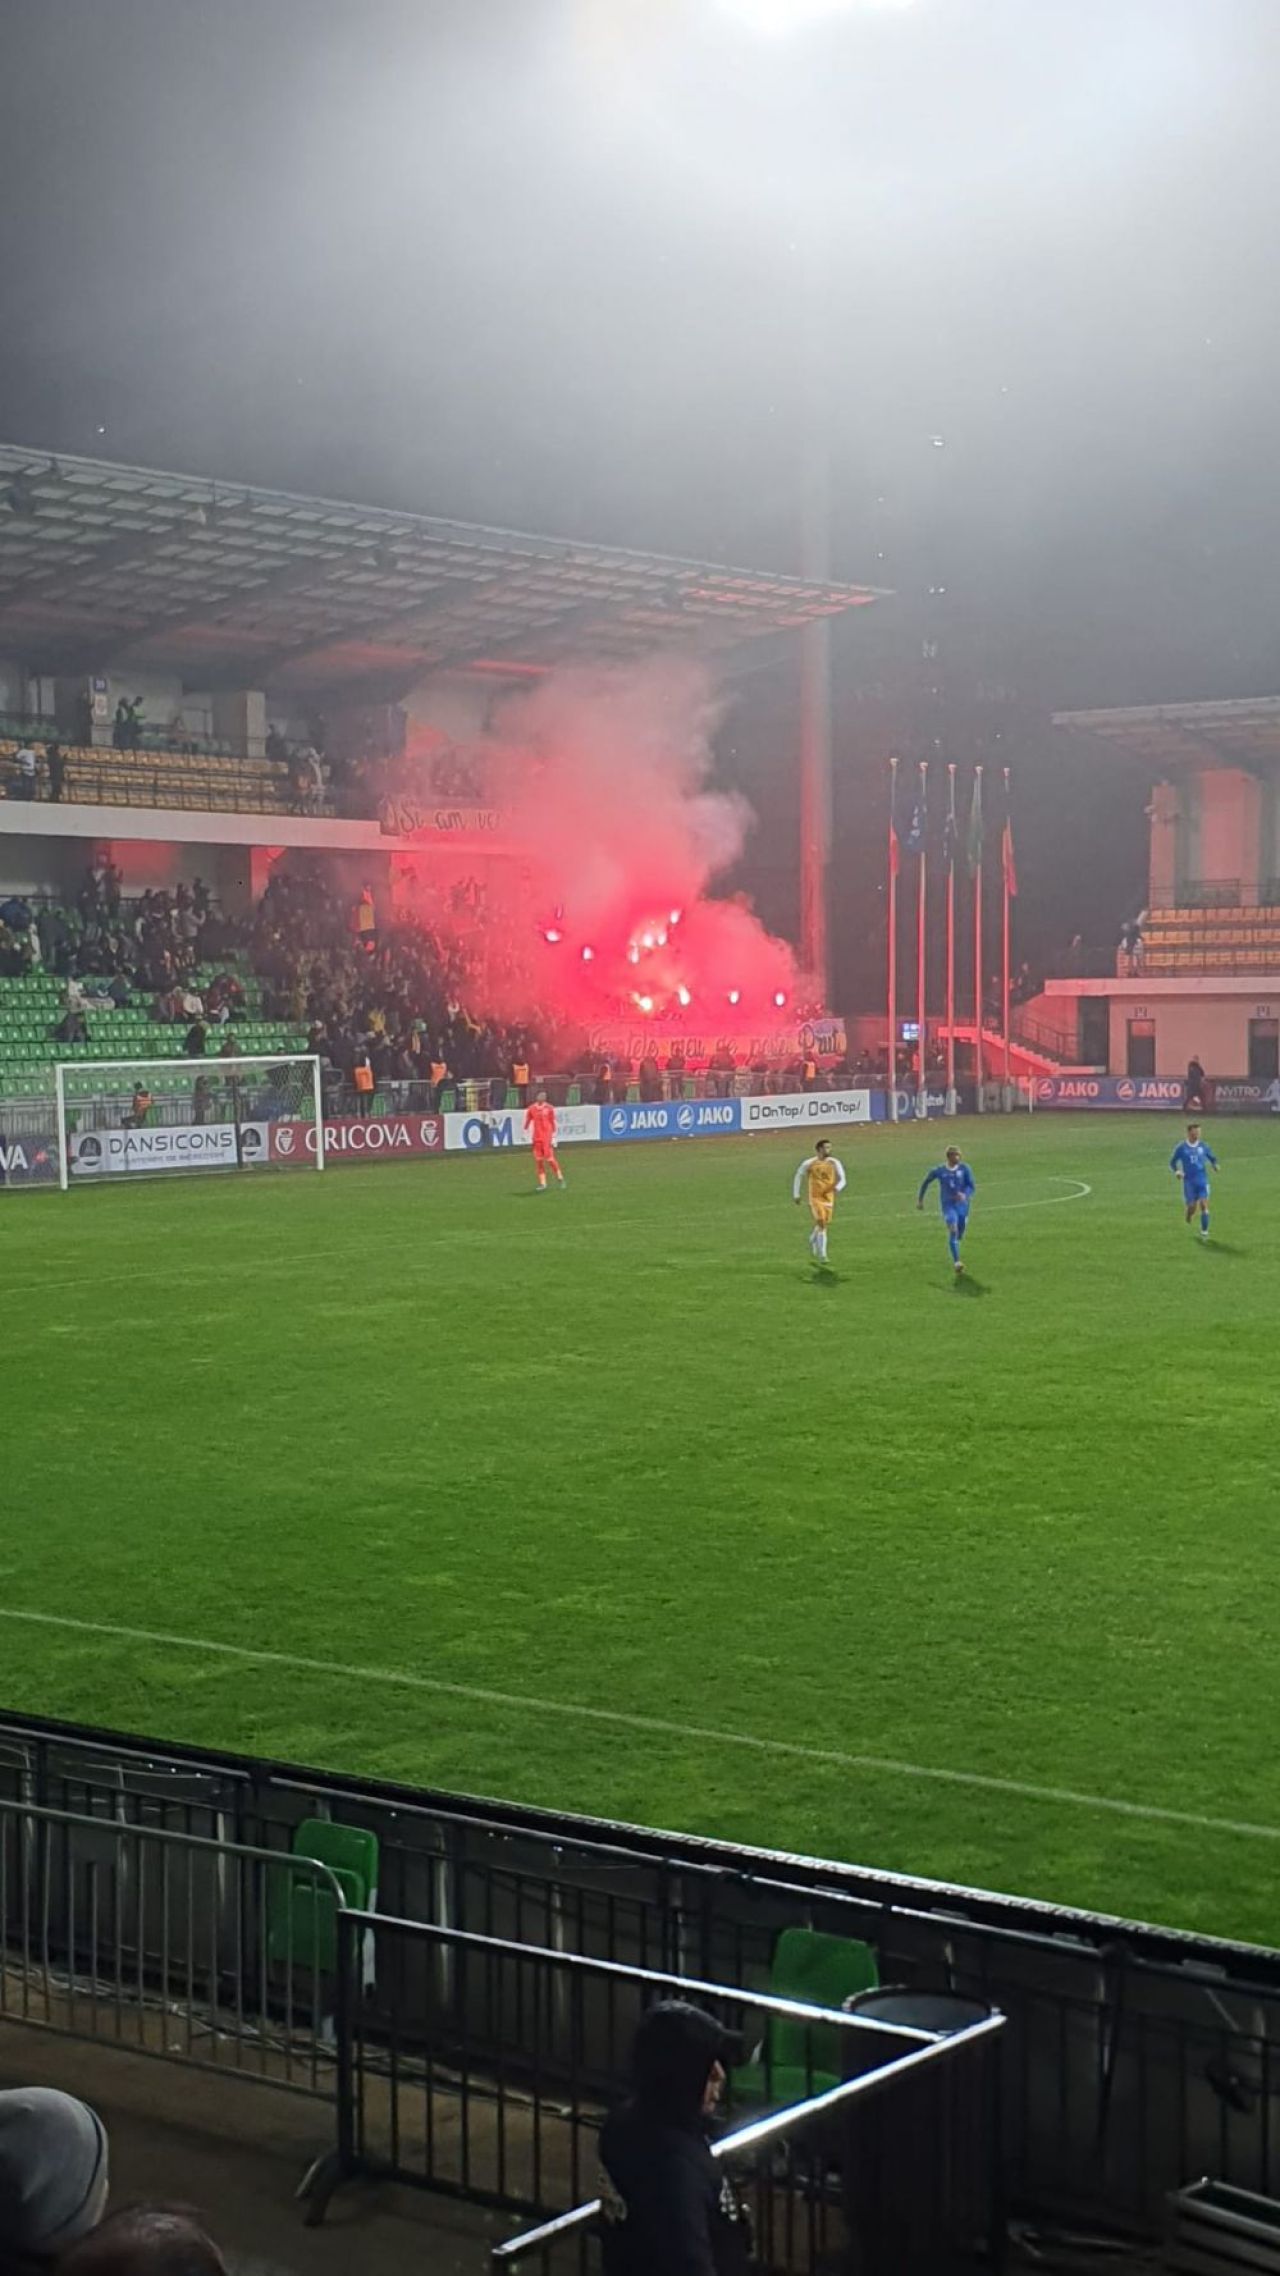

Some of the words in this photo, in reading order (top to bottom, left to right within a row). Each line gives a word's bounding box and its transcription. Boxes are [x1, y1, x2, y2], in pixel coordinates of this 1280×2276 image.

[1058, 1081, 1098, 1096] JAKO
[1139, 1083, 1181, 1098] JAKO
[1216, 1085, 1261, 1097] INVITRO
[631, 1110, 668, 1130] JAKO
[697, 1106, 733, 1126] JAKO
[109, 1132, 234, 1154] DANSICONS
[305, 1123, 412, 1152] CRICOVA
